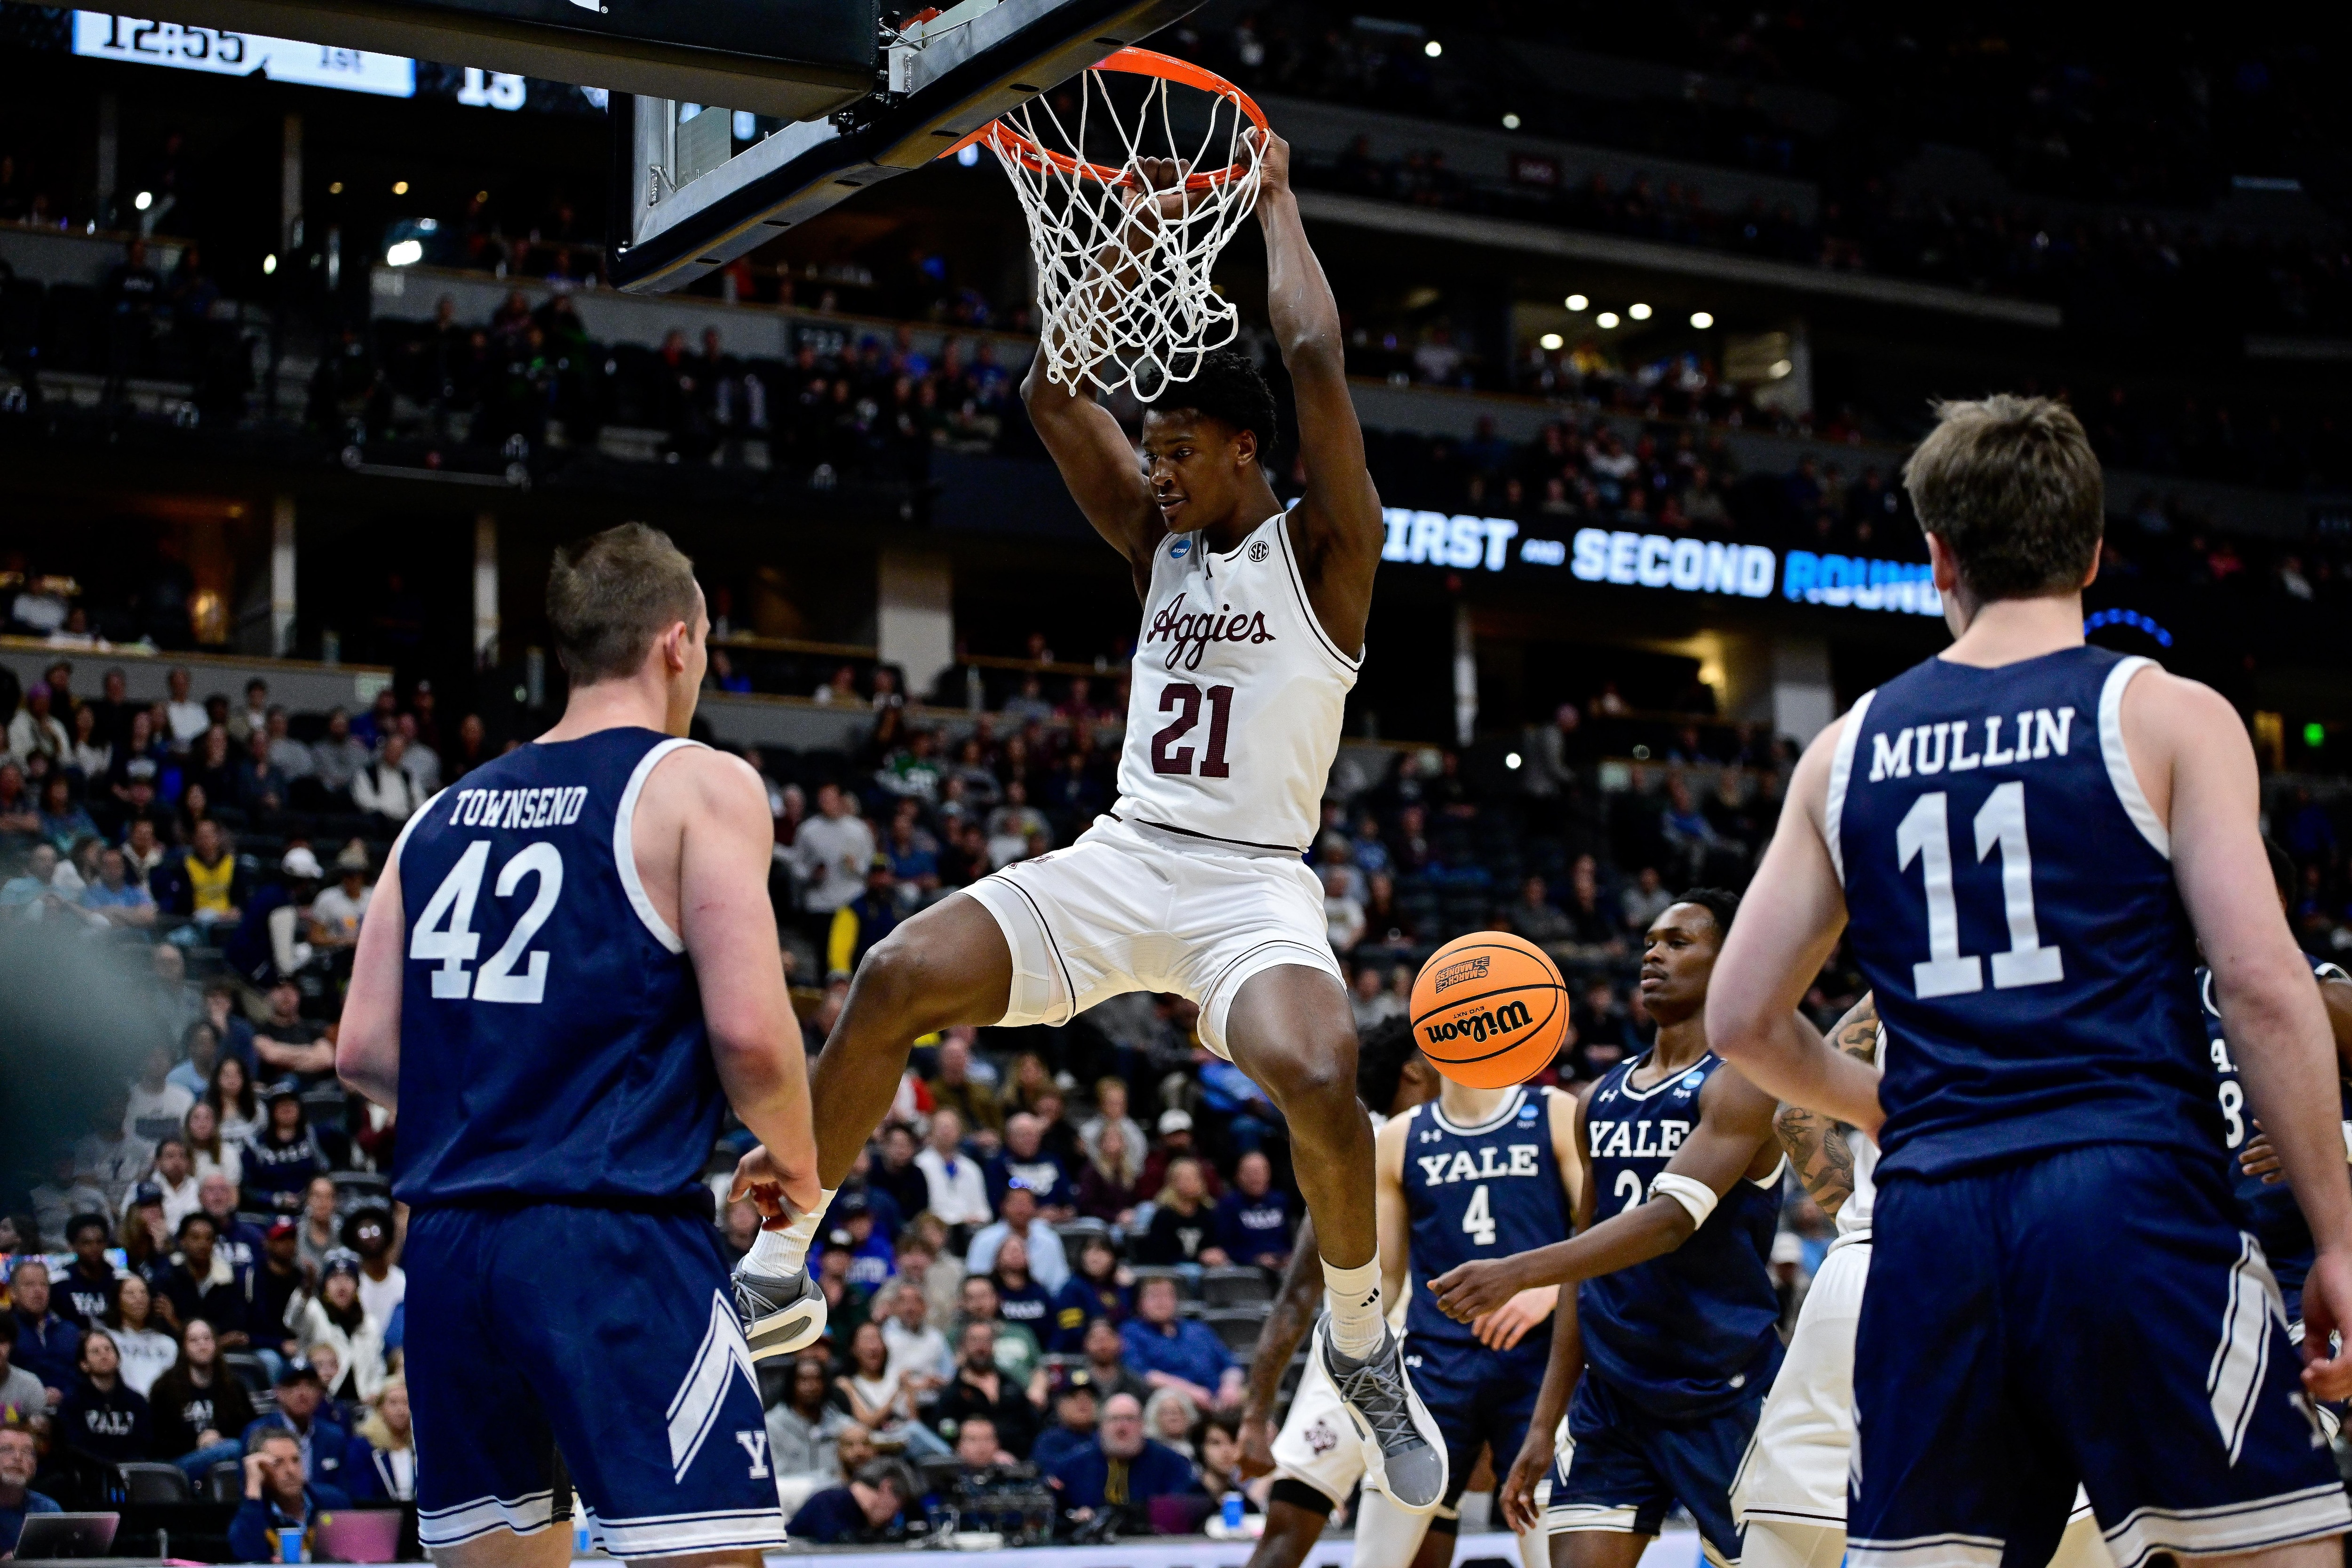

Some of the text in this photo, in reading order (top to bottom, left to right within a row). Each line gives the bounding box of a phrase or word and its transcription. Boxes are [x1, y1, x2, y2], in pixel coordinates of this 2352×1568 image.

[1250, 543, 1267, 560] SEC
[1571, 528, 1775, 598] SECOND
[1146, 592, 1276, 670] Aggies
[1151, 683, 1234, 778] 21
[1868, 707, 2075, 783] MULLIN
[449, 786, 588, 828] TOWNSEND
[1896, 780, 2064, 1000] 11
[409, 840, 564, 1004] 42
[1436, 963, 1473, 983] MADNESS
[1448, 970, 1478, 986] MARCH
[1425, 1000, 1533, 1044] Wilson
[1589, 1120, 1691, 1158] YALE
[1417, 1144, 1539, 1186] YALE
[1462, 1185, 1496, 1246] 4
[736, 1430, 769, 1480] Y
